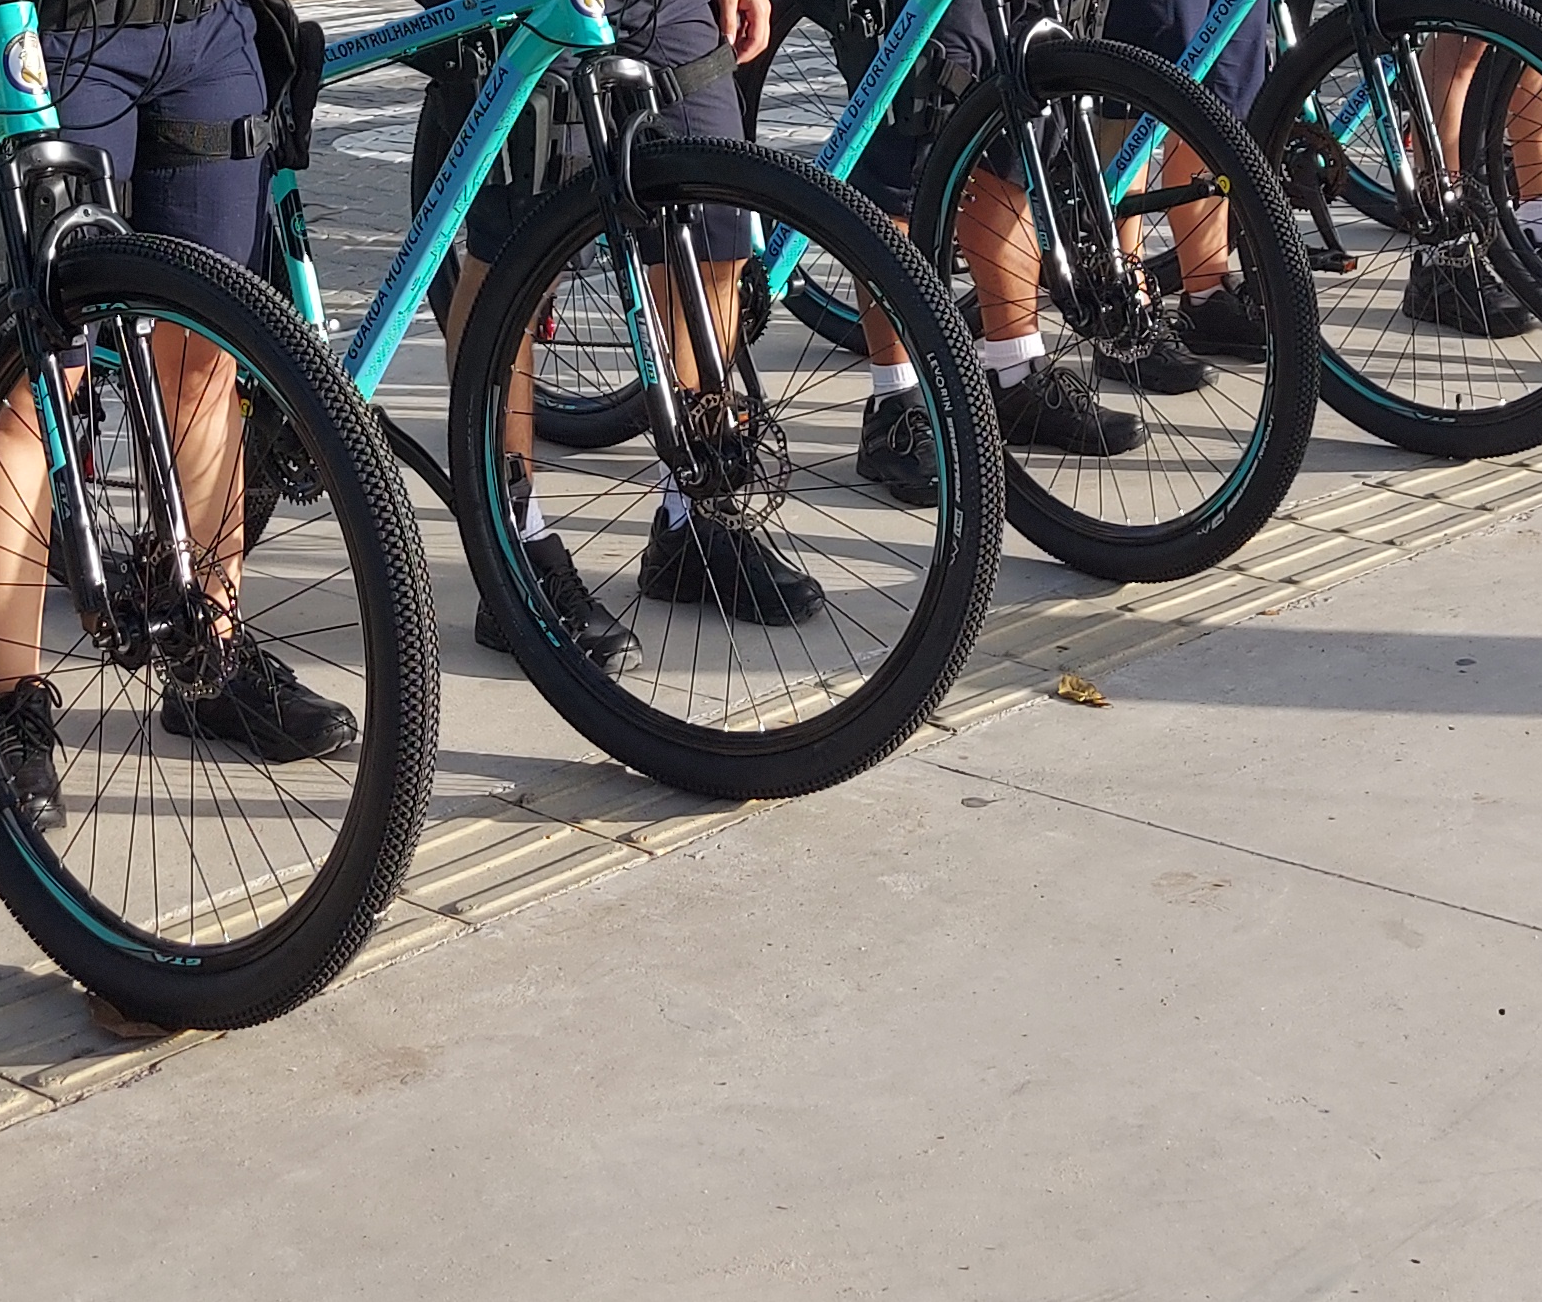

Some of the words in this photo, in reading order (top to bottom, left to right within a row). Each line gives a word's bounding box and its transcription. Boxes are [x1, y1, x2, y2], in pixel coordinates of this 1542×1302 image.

[1198, 16, 1215, 44] DE
[816, 112, 852, 171] ICIPAL
[848, 93, 865, 120] DE
[860, 10, 917, 98] FORTALEZA
[1115, 114, 1155, 172] GUARDA
[346, 286, 388, 362] GUARDA
[383, 195, 439, 290] MUNICIPAL
[435, 165, 455, 196] DE
[449, 64, 510, 164] FORTALEZA
[81, 302, 131, 314] GTA
[925, 351, 953, 413] LEVORIN
